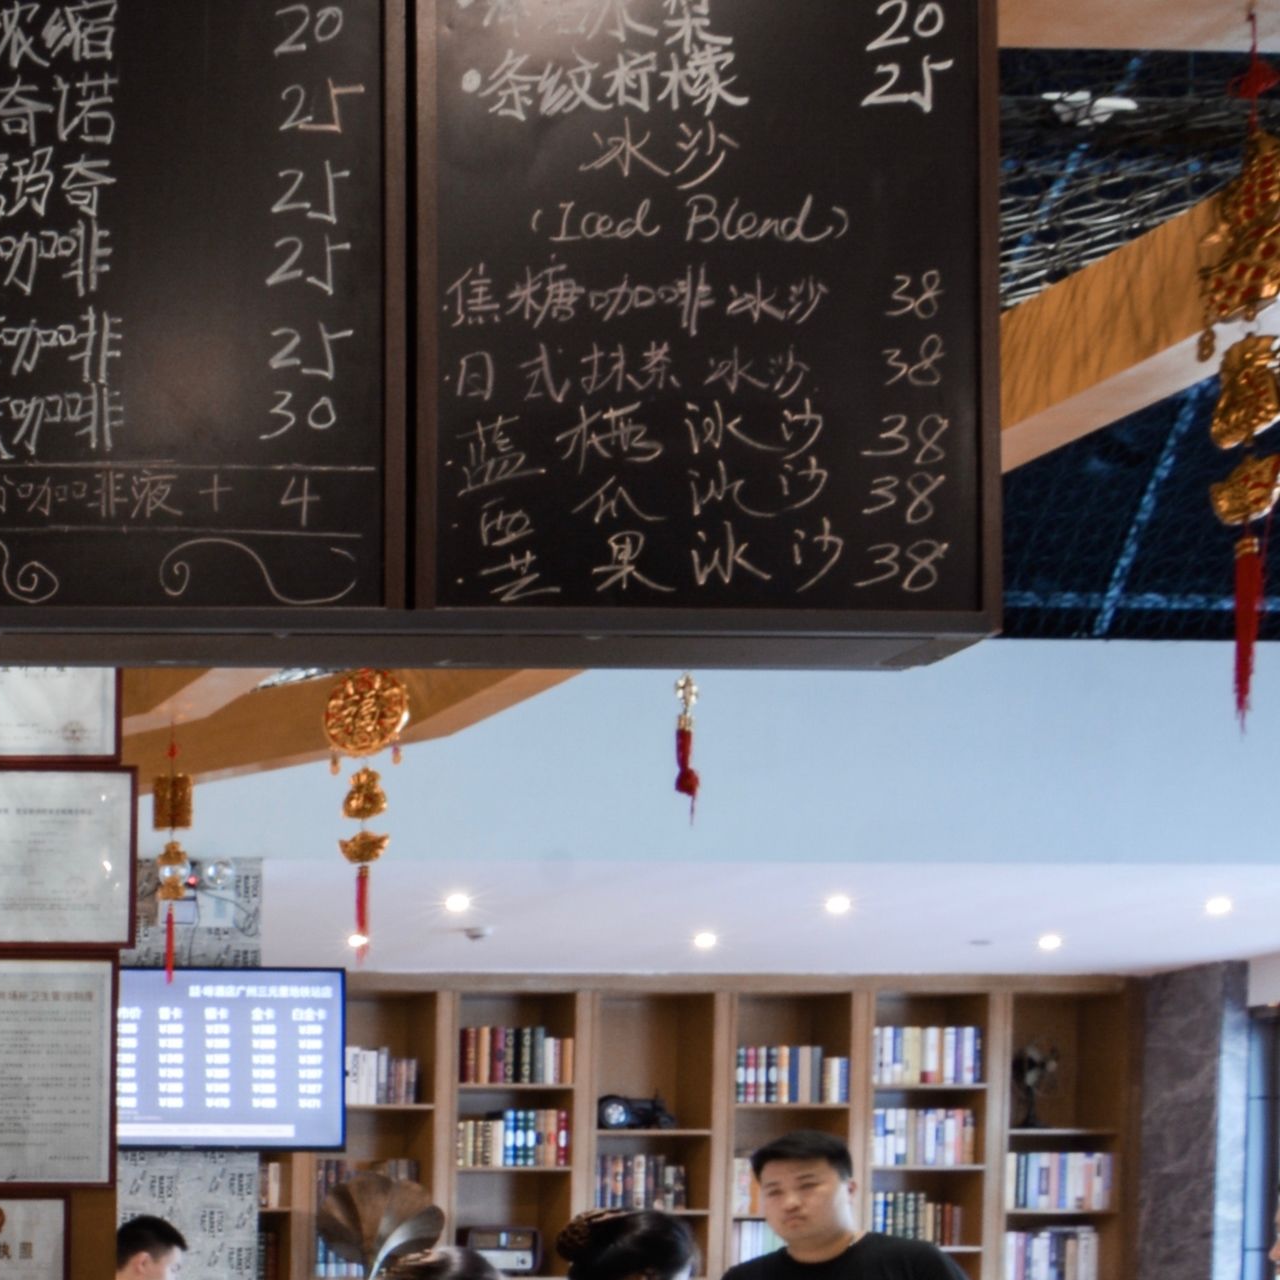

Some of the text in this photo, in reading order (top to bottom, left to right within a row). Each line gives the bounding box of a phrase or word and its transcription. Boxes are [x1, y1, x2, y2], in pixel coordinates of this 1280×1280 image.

[274, 4, 343, 54] 20
[866, 0, 944, 51] 20
[279, 77, 365, 132] 25
[480, 46, 953, 121] 条纹柠檬 25
[579, 116, 739, 190] 冰沙
[272, 160, 350, 223] 25
[266, 234, 351, 294] 25
[446, 262, 942, 336] 焦糖咖啡冰沙 38
[269, 322, 353, 380] 25
[456, 334, 945, 402] 日式抹茶冰沙 38
[259, 391, 337, 440] 30
[861, 414, 948, 464] 38
[281, 476, 321, 526] 4
[481, 457, 946, 546] 西瓜冰沙 38
[480, 517, 949, 602] 芒果冰沙 38
